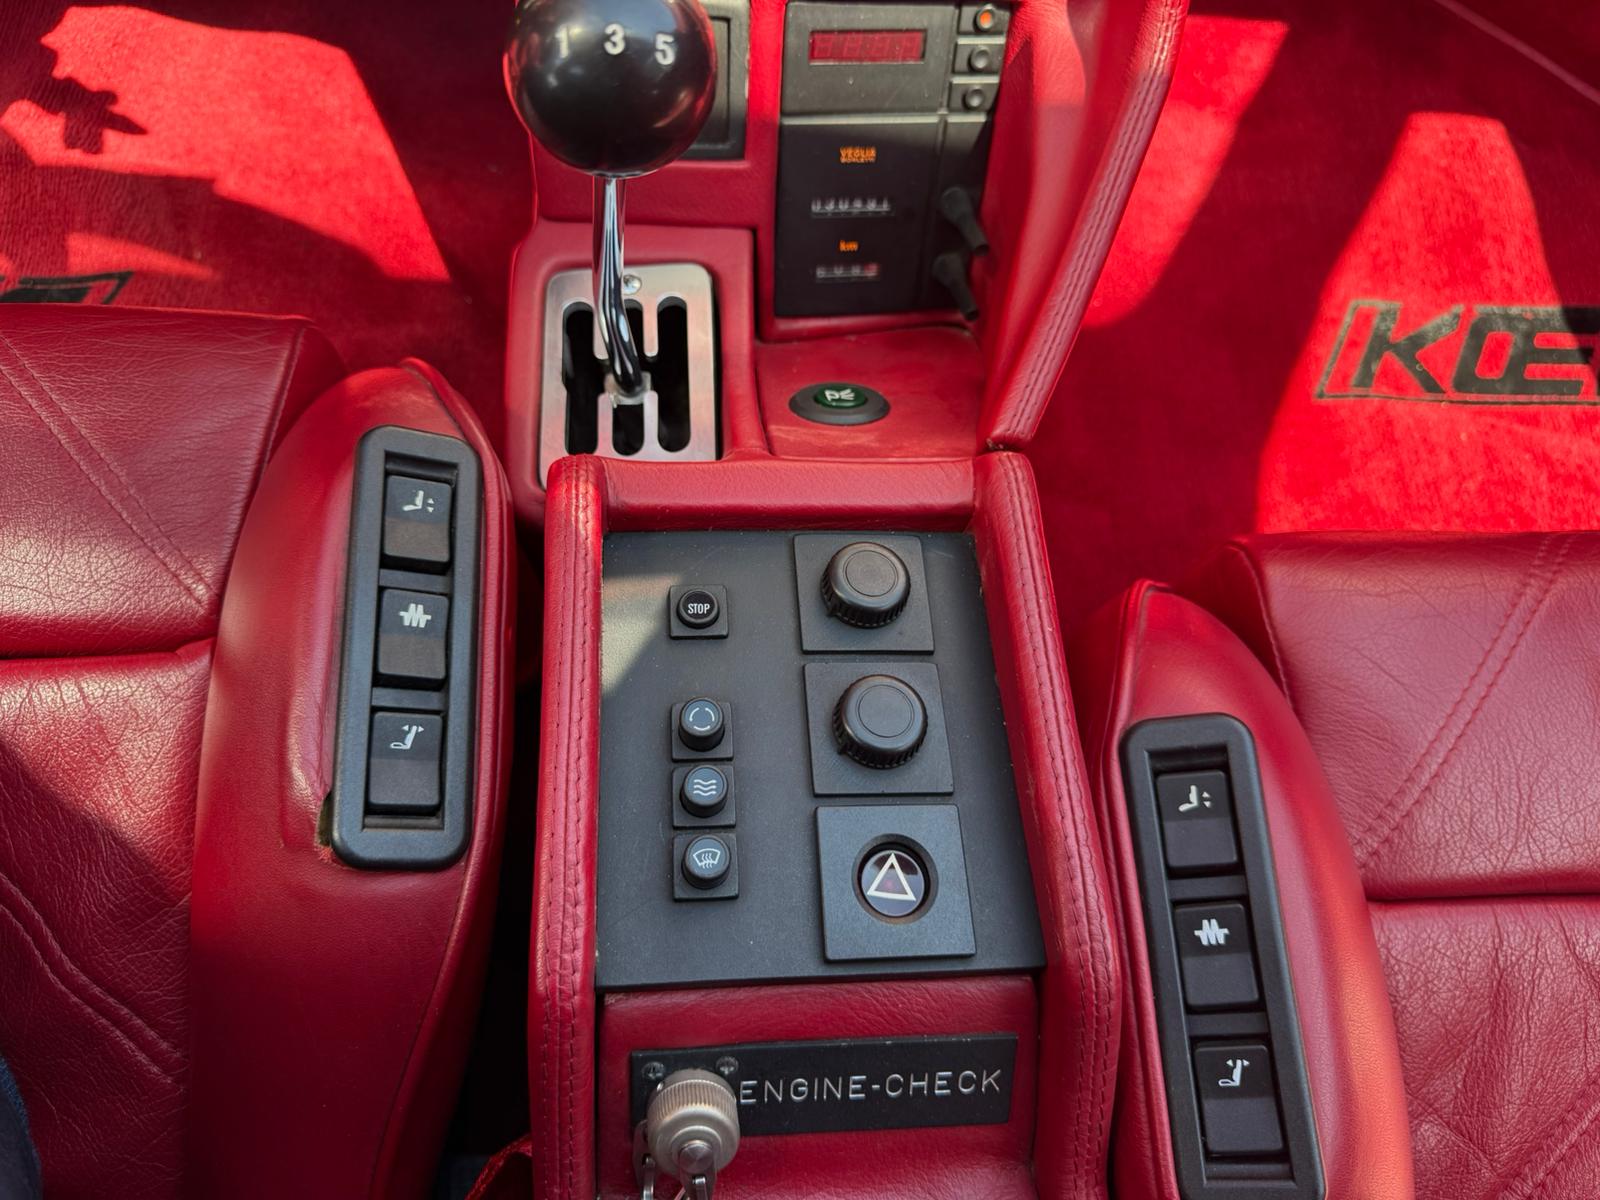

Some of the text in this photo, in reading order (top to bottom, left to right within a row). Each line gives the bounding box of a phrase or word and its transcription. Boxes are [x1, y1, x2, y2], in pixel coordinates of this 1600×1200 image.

[555, 23, 675, 65] 1 3 5
[1350, 301, 1600, 396] KOE
[687, 603, 710, 614] STOP
[739, 1069, 1001, 1104] ENGINE-CHECK
